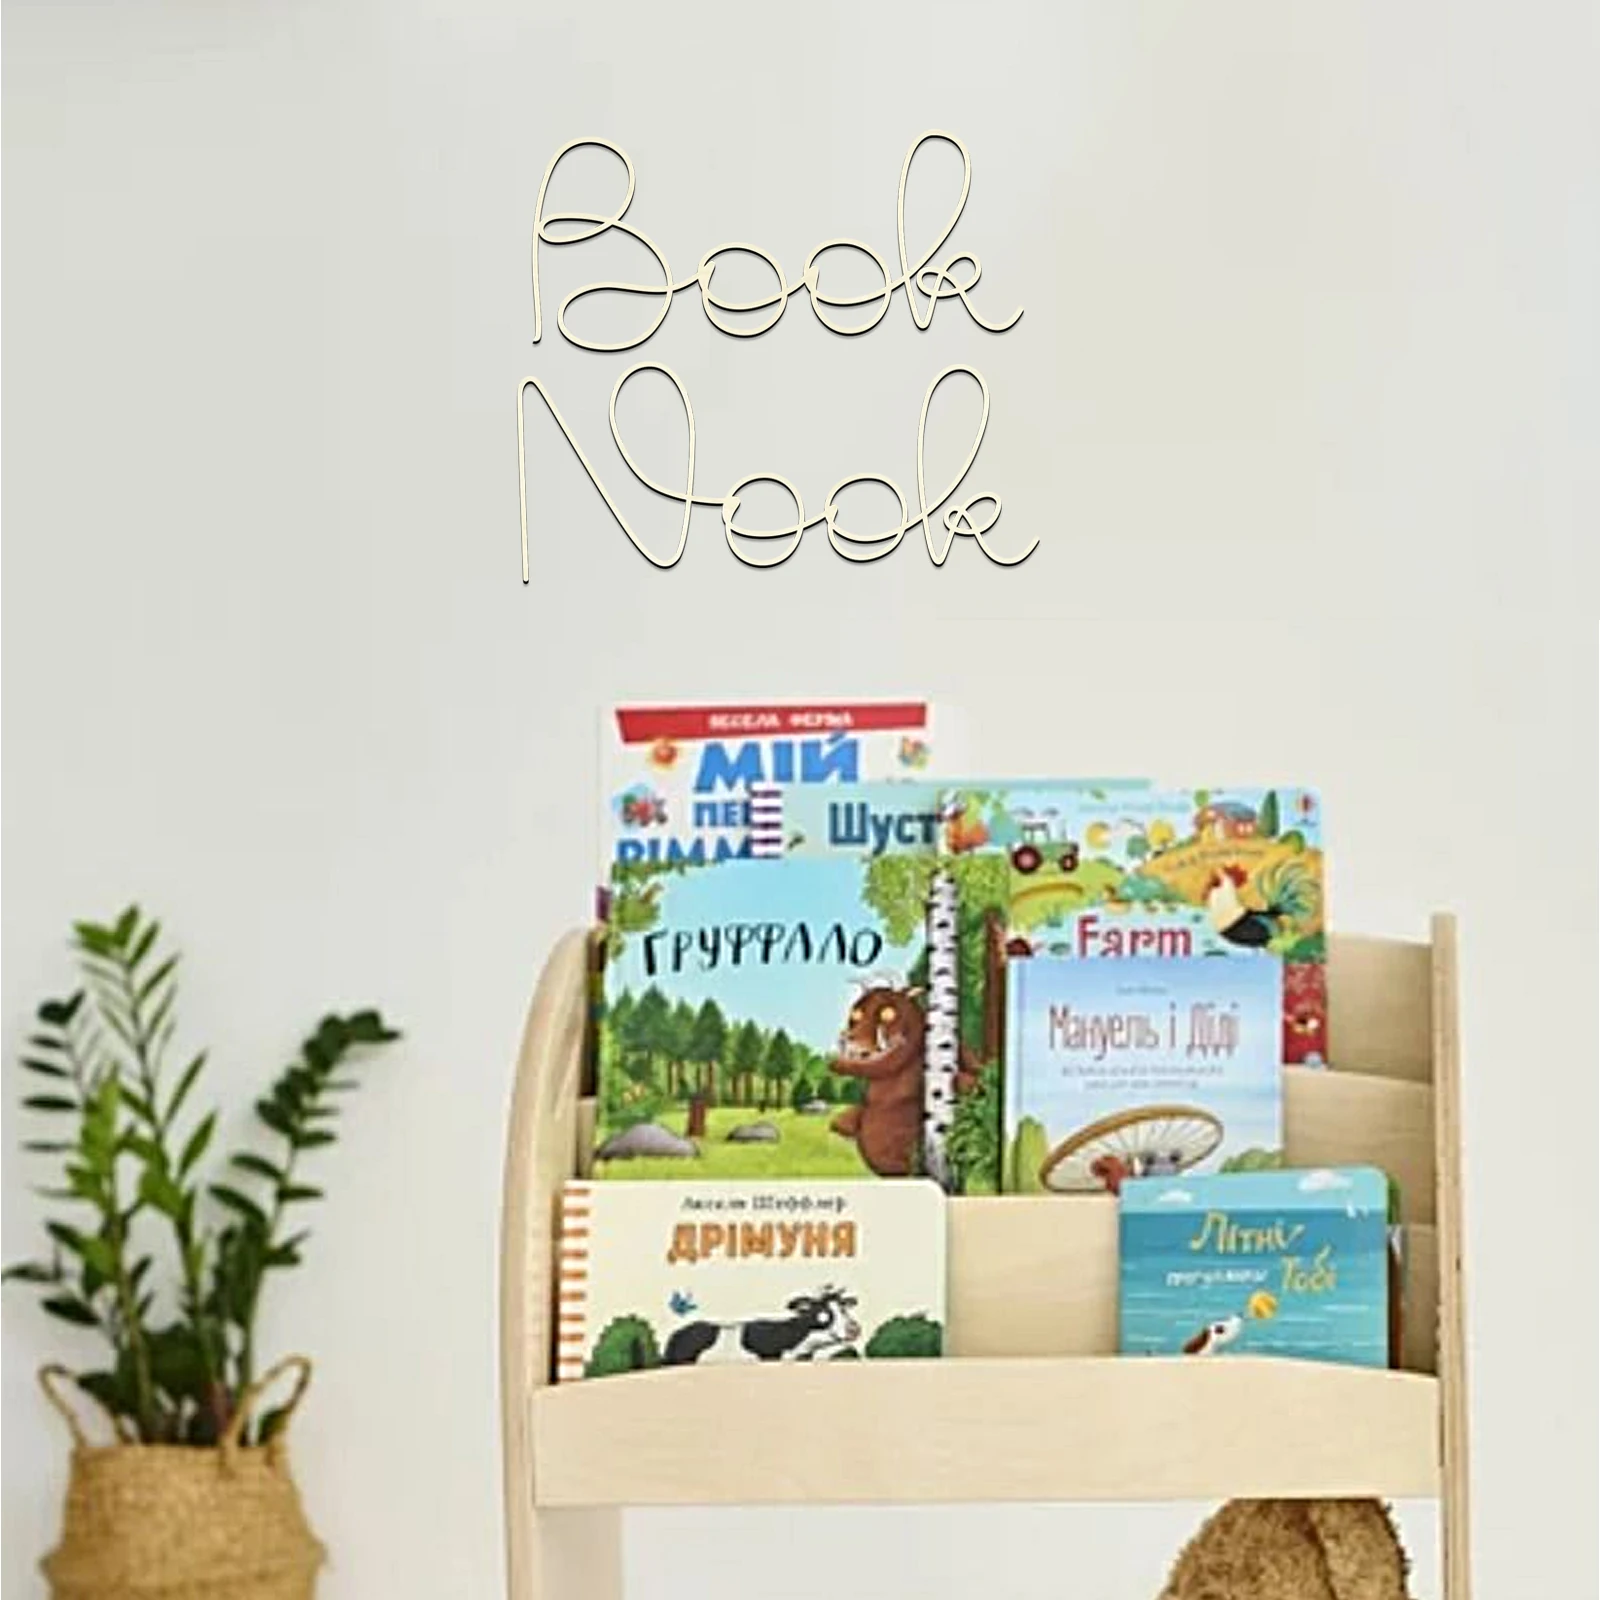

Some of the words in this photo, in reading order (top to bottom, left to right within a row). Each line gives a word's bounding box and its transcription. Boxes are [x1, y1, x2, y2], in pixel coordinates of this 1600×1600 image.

[532, 128, 1025, 352] Book
[517, 361, 1040, 584] Nook
[693, 731, 860, 794] МІЙ
[1077, 914, 1192, 958] Farm
[666, 1220, 858, 1264] ДРІМУНЯ
